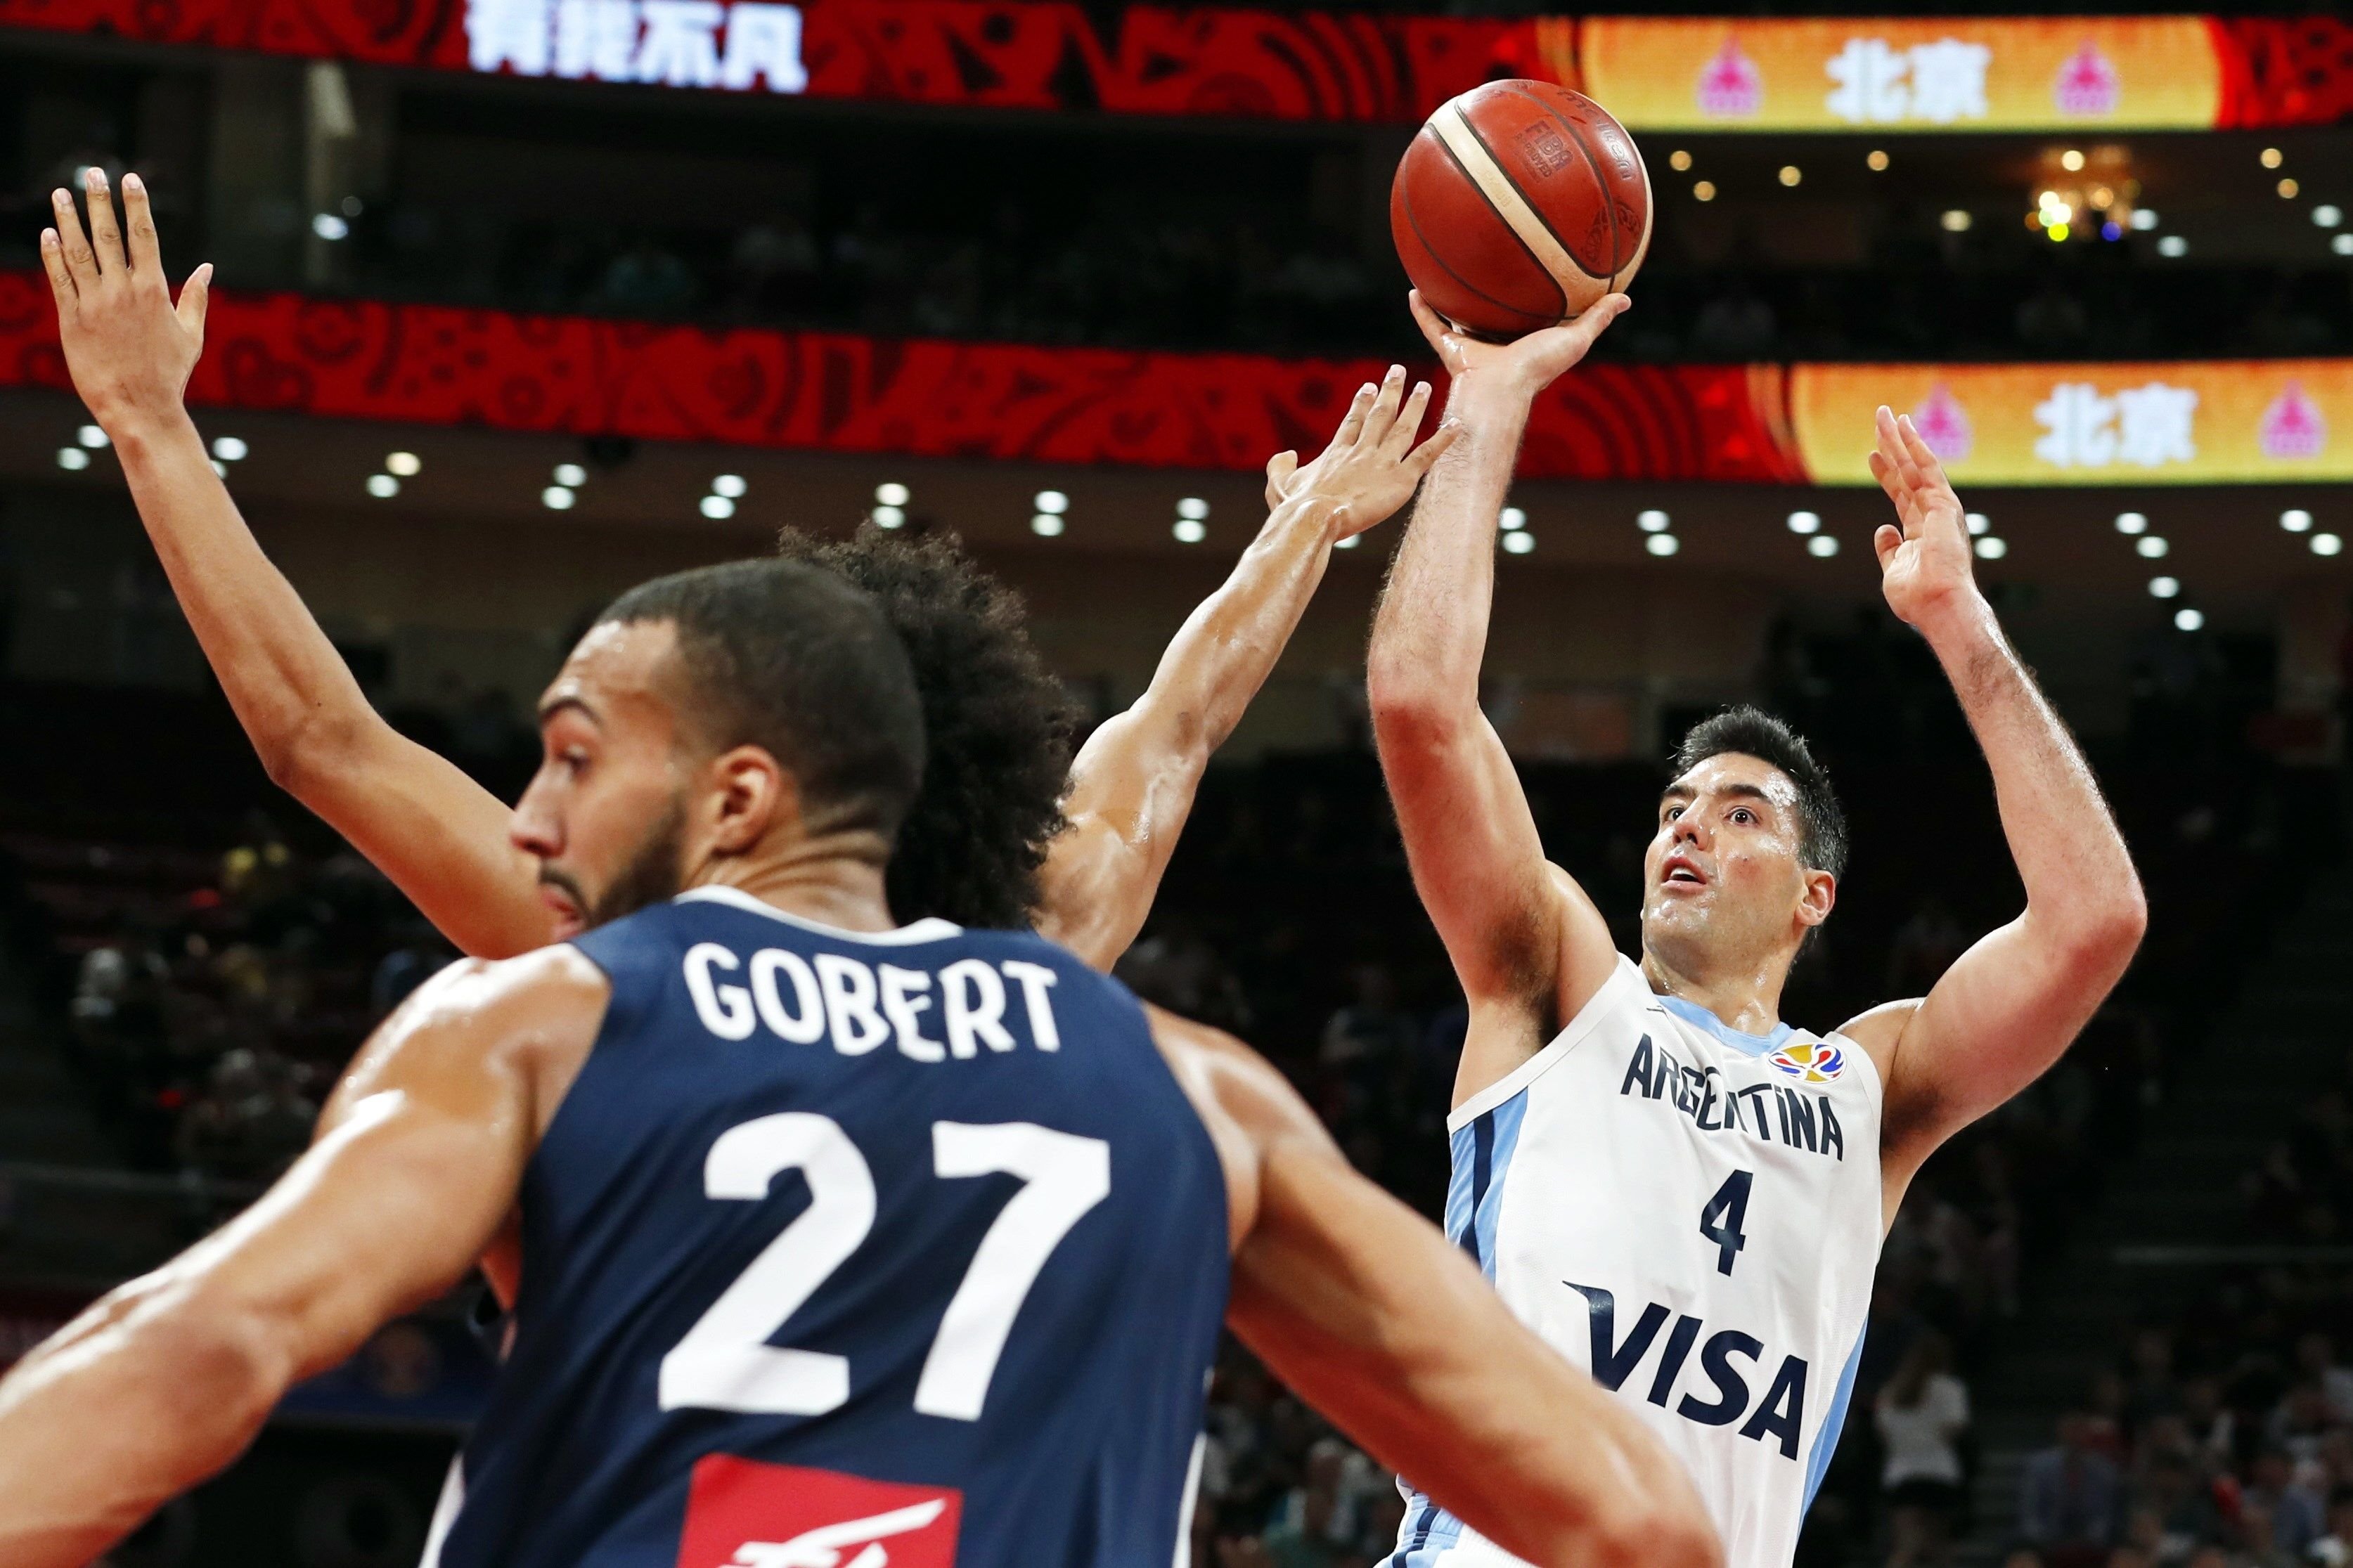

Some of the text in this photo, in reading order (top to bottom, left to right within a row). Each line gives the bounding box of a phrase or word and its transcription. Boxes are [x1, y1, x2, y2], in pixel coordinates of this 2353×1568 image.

[1826, 39, 1989, 122] 北京
[1524, 119, 1574, 173] FIBA
[2035, 383, 2197, 468] 北京
[682, 942, 1061, 1063] GOBERT
[1620, 1033, 1844, 1162] ARGENTINA
[658, 1110, 1111, 1421] 27
[1699, 1169, 1753, 1277] 4
[1562, 1280, 1809, 1462] VISA
